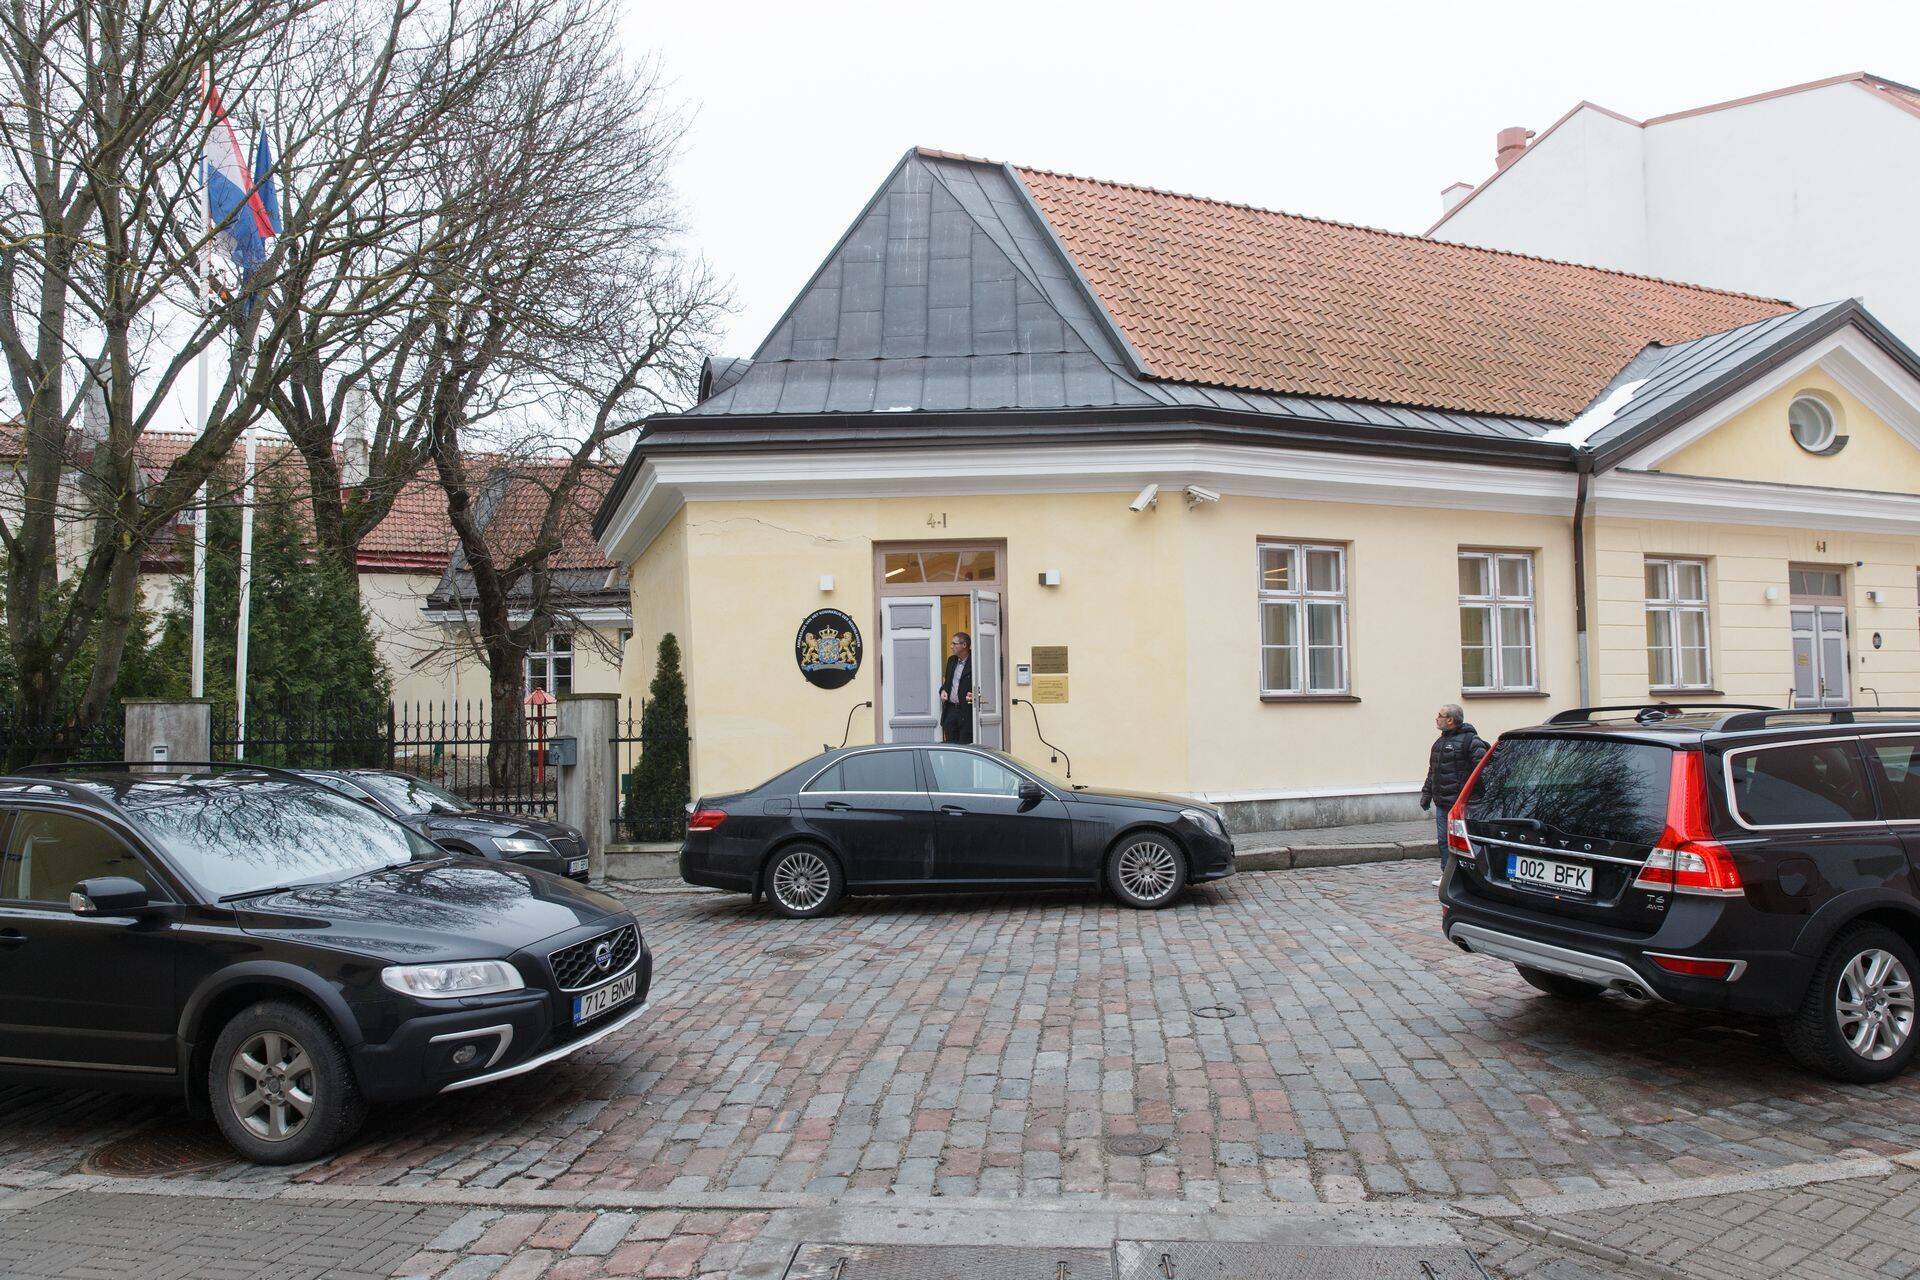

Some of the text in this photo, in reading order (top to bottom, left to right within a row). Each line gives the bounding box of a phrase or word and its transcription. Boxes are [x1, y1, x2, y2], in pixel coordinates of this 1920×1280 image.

[1500, 831, 1592, 850] VOLVO
[1520, 859, 1545, 880] 002
[1554, 864, 1587, 888] BFK
[1646, 894, 1665, 904] T6
[585, 976, 634, 1015] 712 BNM
